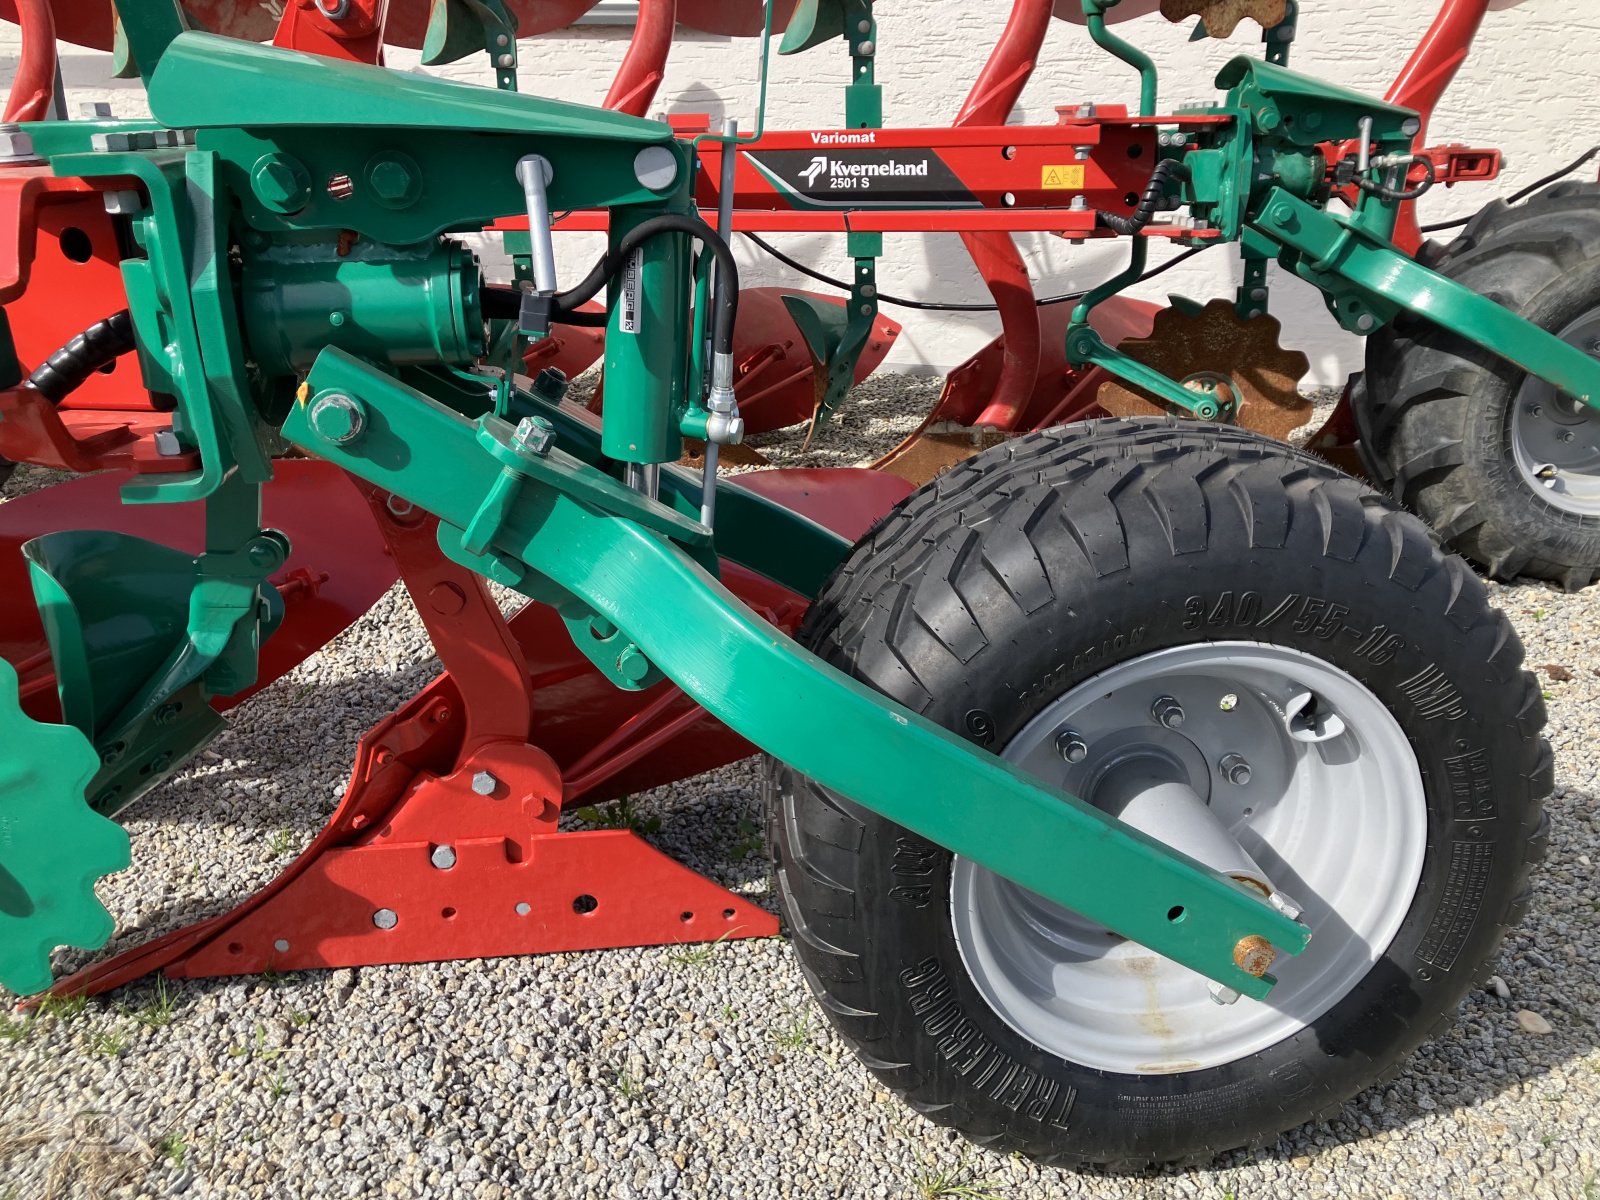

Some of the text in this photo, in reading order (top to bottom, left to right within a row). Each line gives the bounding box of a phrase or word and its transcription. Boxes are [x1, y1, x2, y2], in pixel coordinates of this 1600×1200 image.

[810, 131, 876, 144] Variomat
[829, 159, 928, 177] Kverneland
[829, 177, 870, 189] 2501 S
[1182, 591, 1407, 666] 340/55-16
[900, 956, 1078, 1130] TRELLEBORG
